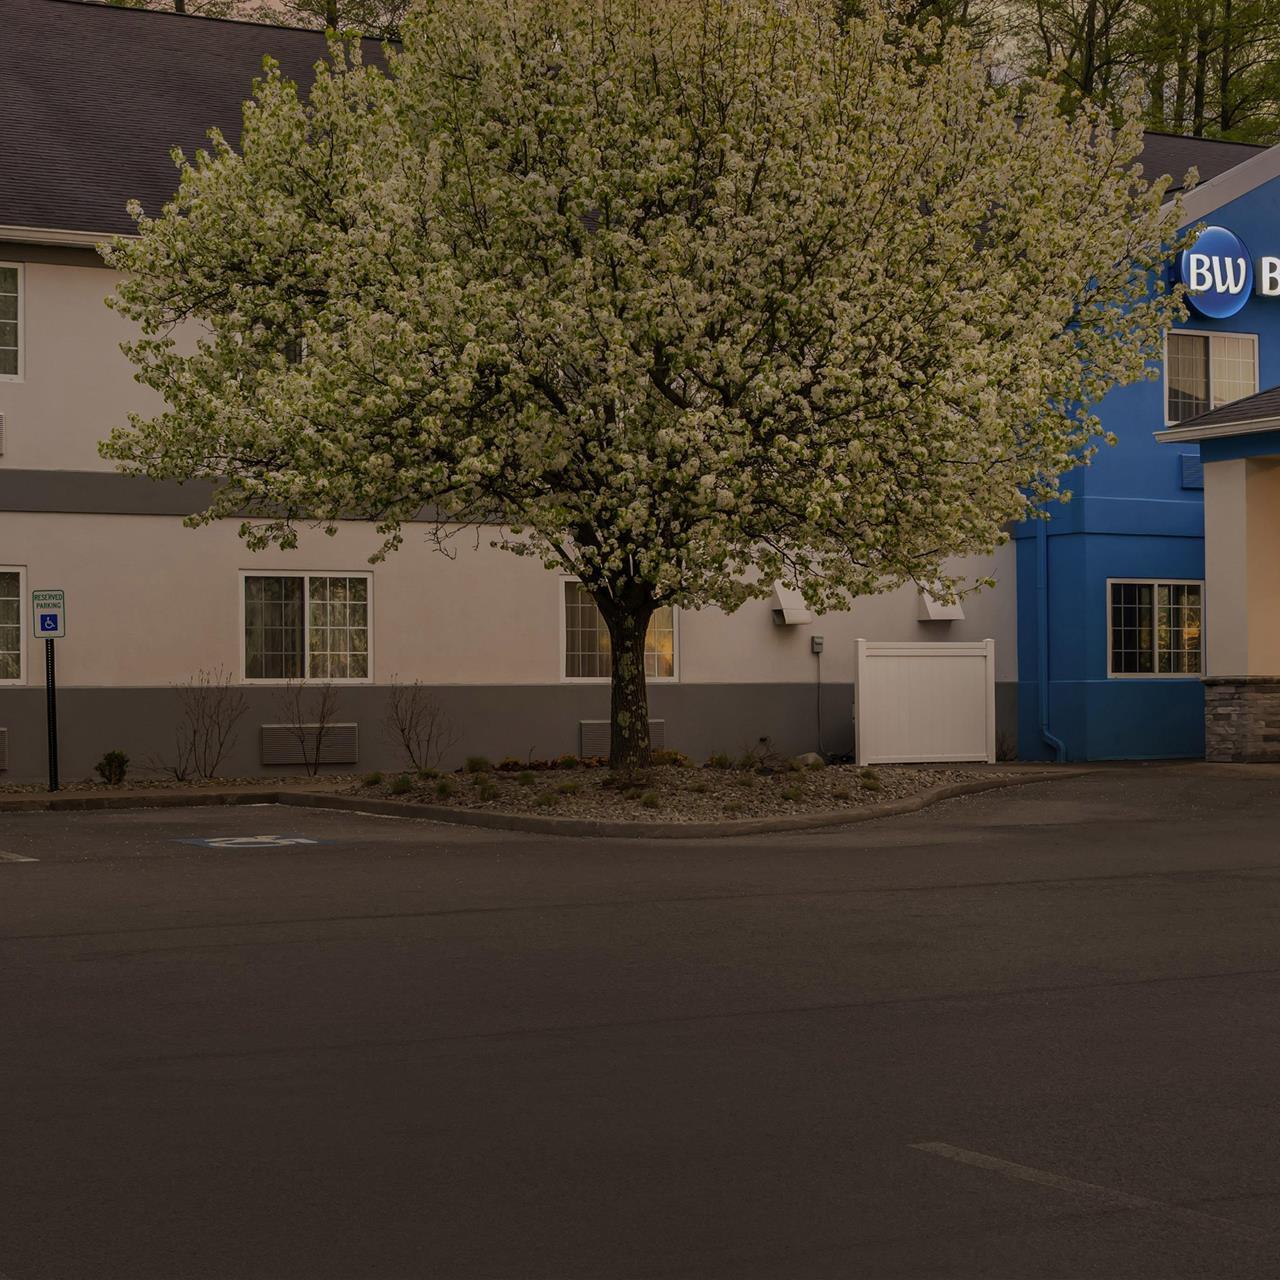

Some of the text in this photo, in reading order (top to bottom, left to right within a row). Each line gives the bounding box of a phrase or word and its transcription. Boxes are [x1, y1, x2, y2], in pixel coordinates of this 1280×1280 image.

[1189, 253, 1246, 295] BW
[34, 593, 63, 601] RESERVED
[36, 601, 62, 609] PARKING
